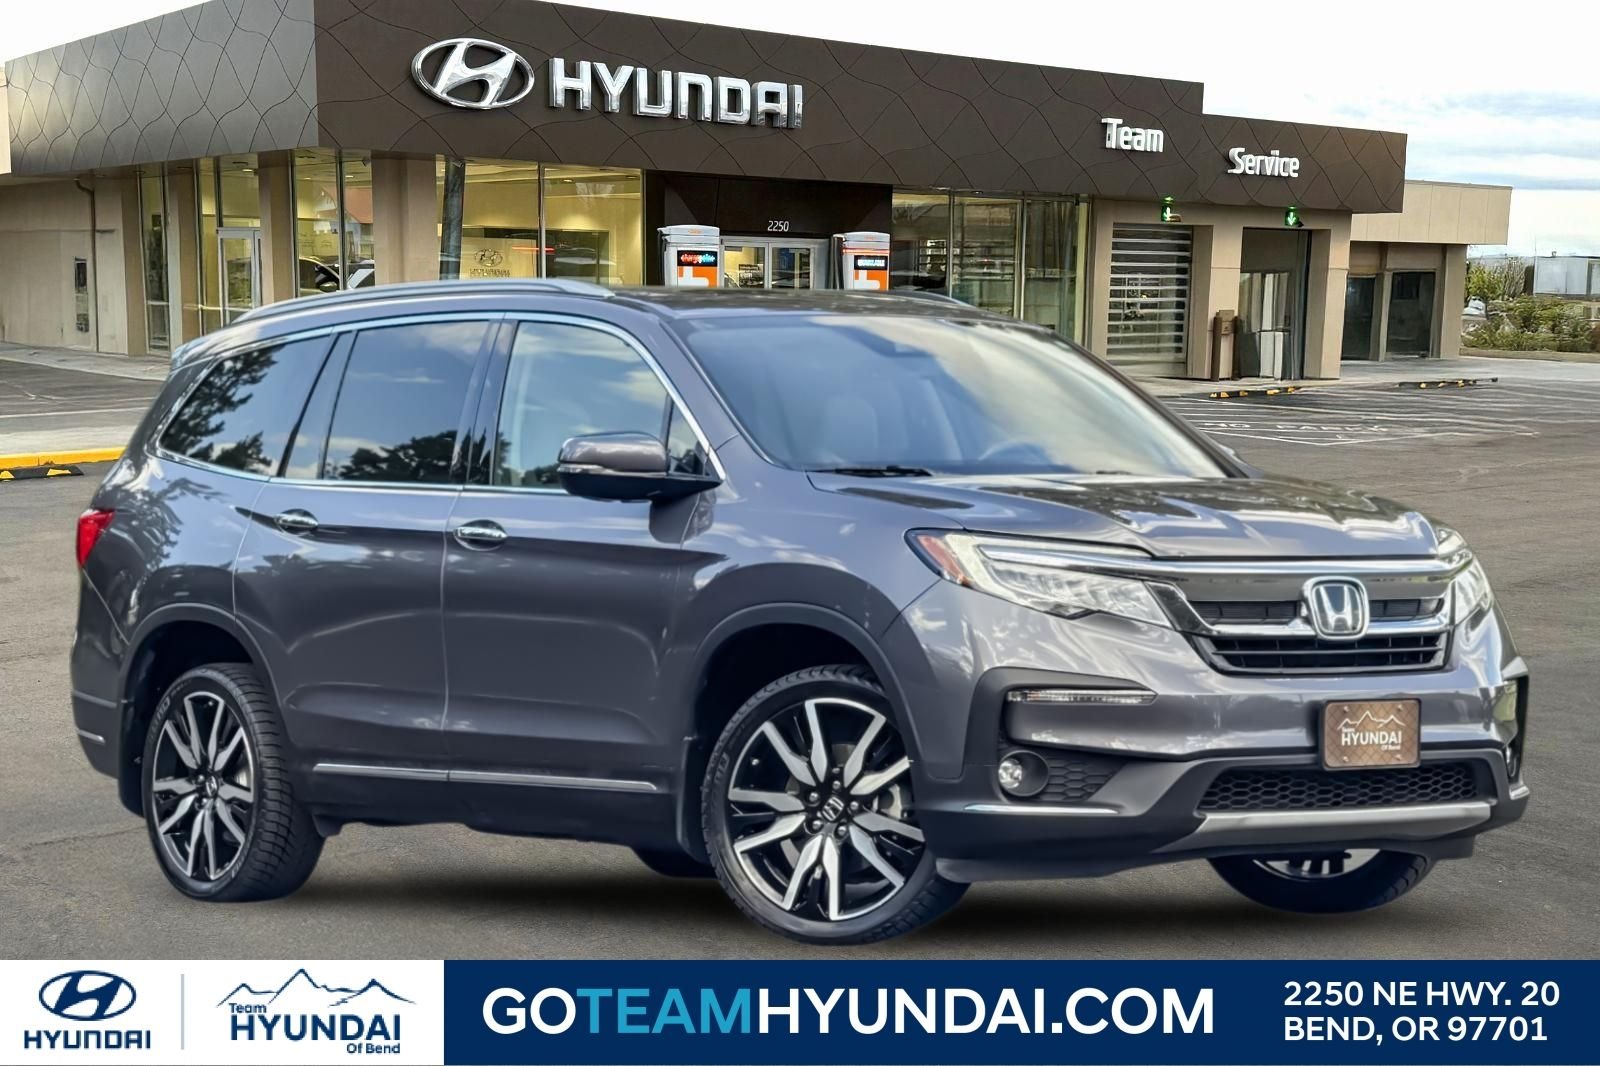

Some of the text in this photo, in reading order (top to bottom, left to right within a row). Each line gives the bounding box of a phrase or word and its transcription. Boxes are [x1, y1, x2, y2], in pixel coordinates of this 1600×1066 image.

[548, 56, 803, 129] HYUNDAI
[1101, 117, 1164, 153] Team
[1227, 147, 1300, 178] Service
[767, 220, 790, 232] 2250
[1341, 730, 1402, 747] HYUNDAI
